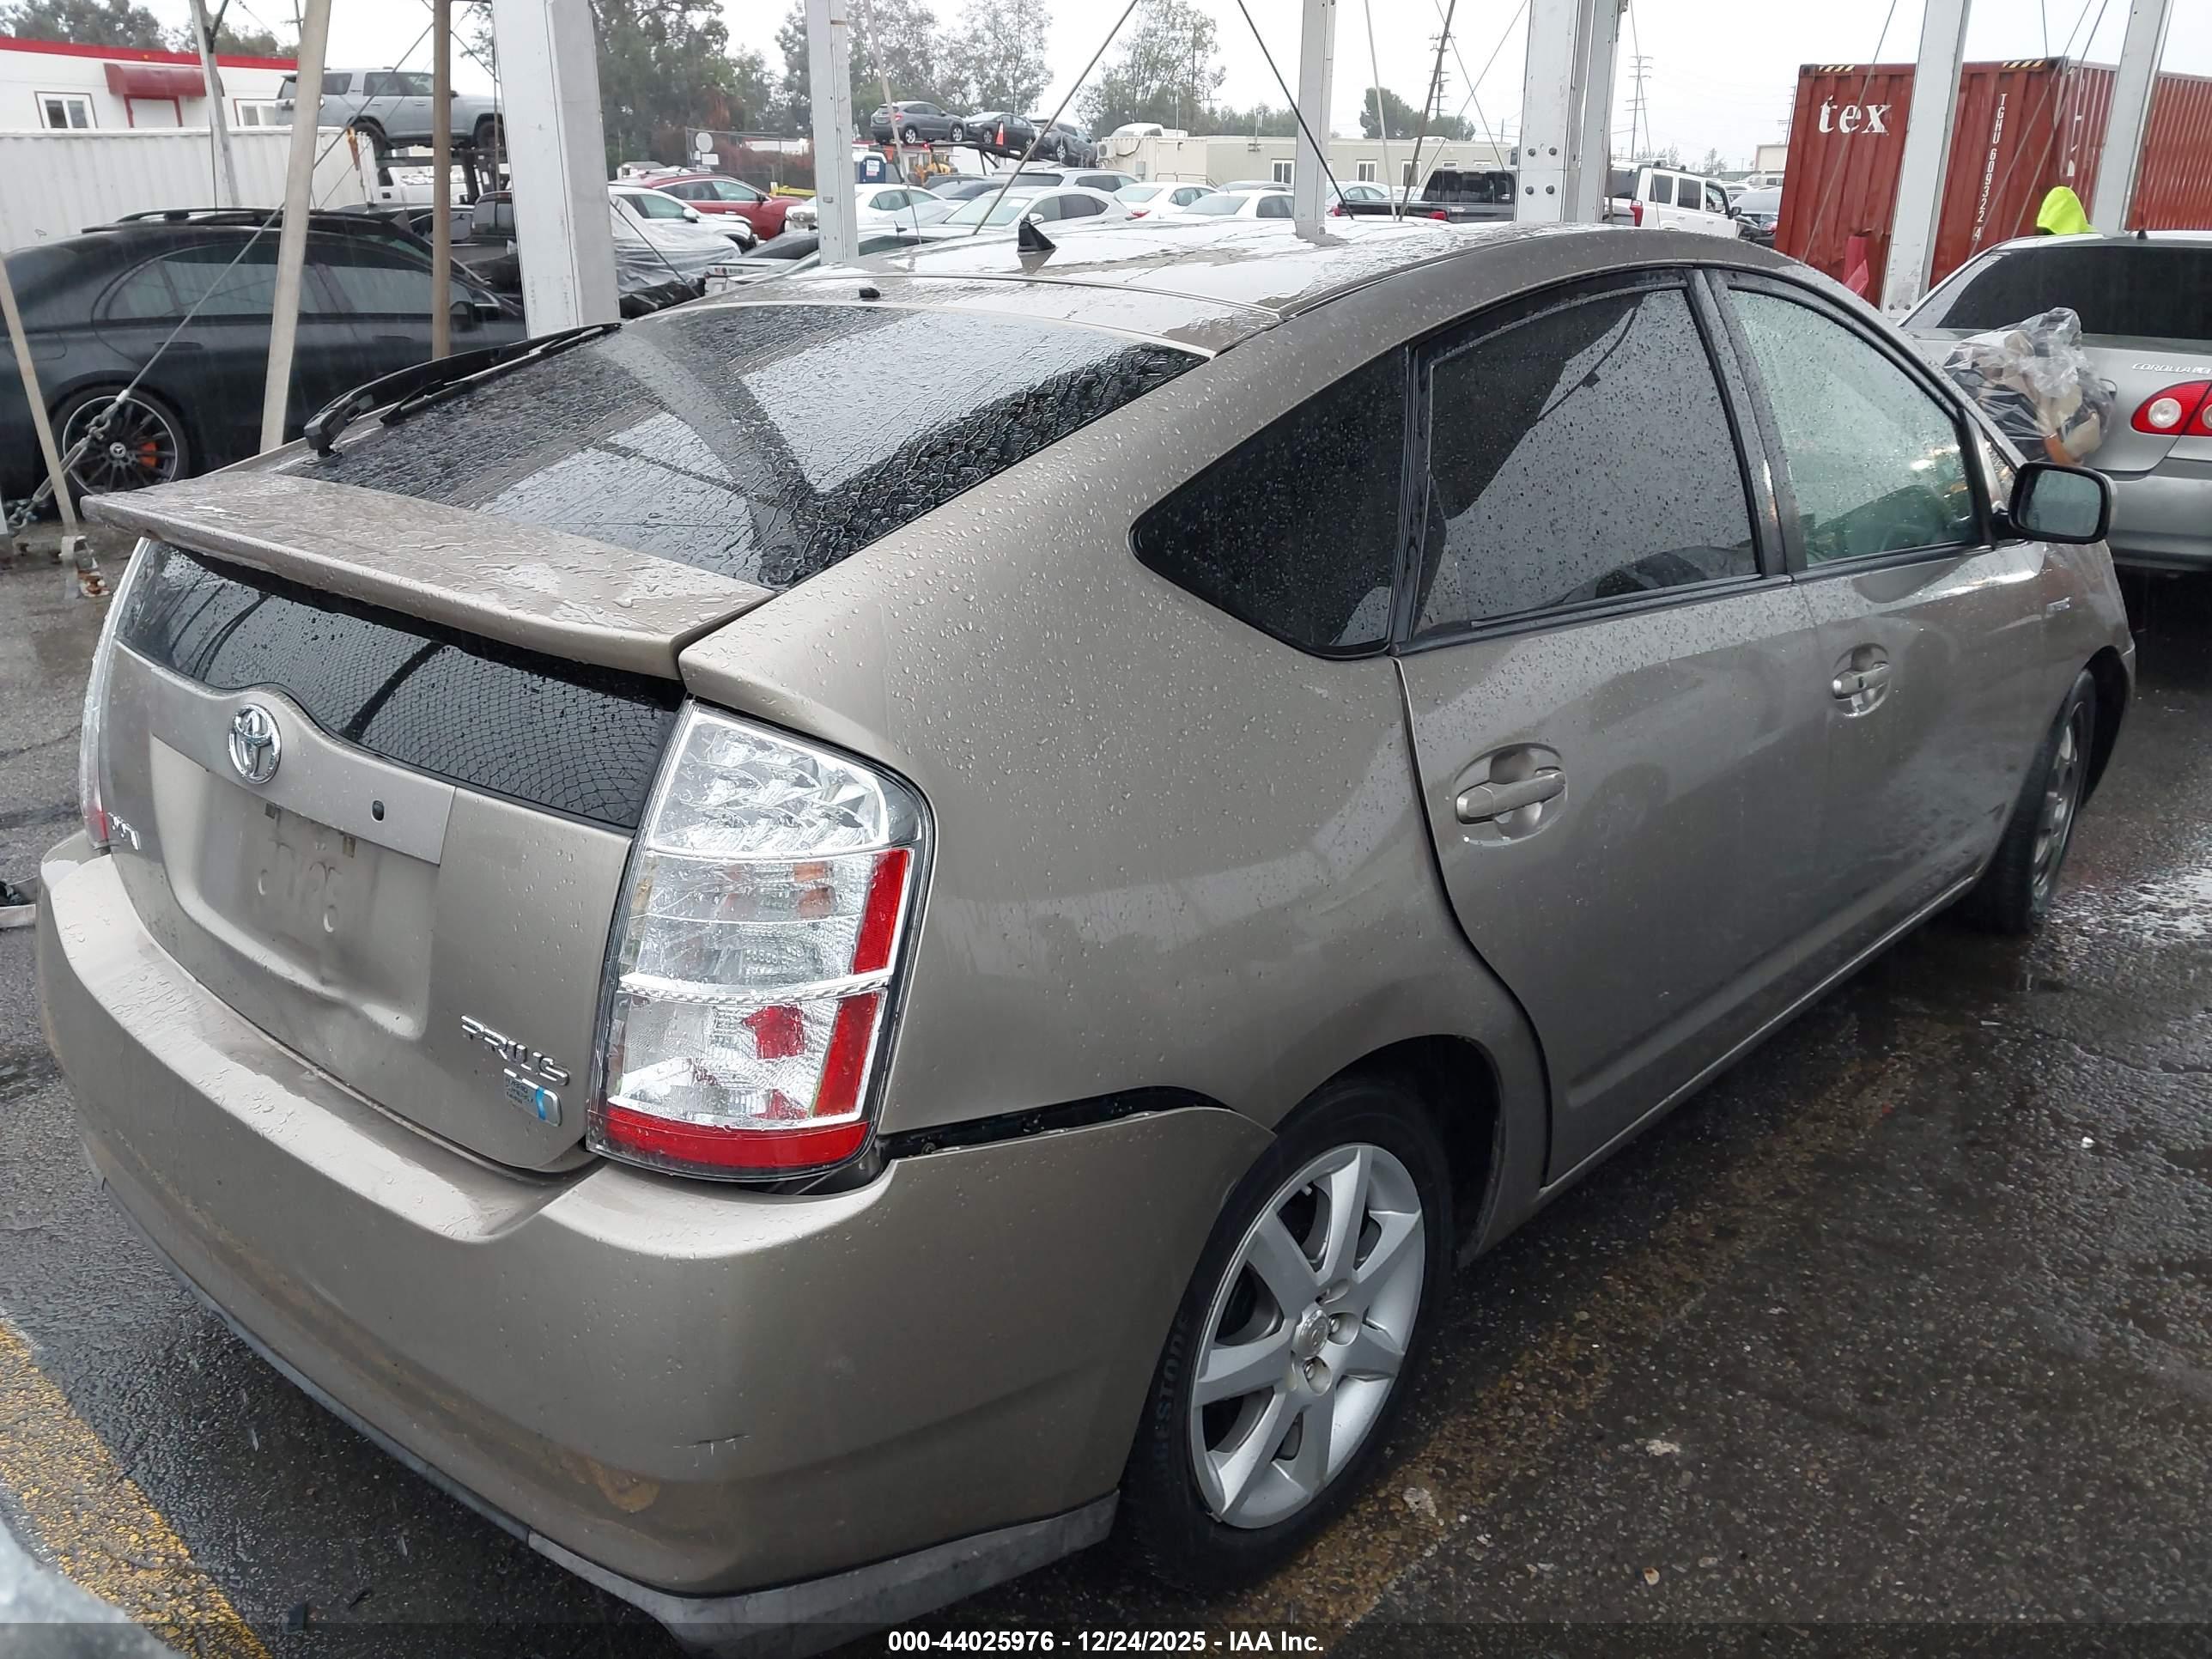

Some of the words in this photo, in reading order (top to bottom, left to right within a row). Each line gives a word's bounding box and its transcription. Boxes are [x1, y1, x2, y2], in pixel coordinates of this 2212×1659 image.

[1819, 94, 1893, 134] tex
[1992, 93, 2008, 144] TGHU
[1977, 148, 1998, 223] 609322
[1972, 227, 1983, 241] 4
[2131, 362, 2191, 373] COROLLA
[460, 1013, 570, 1086] PRIUS
